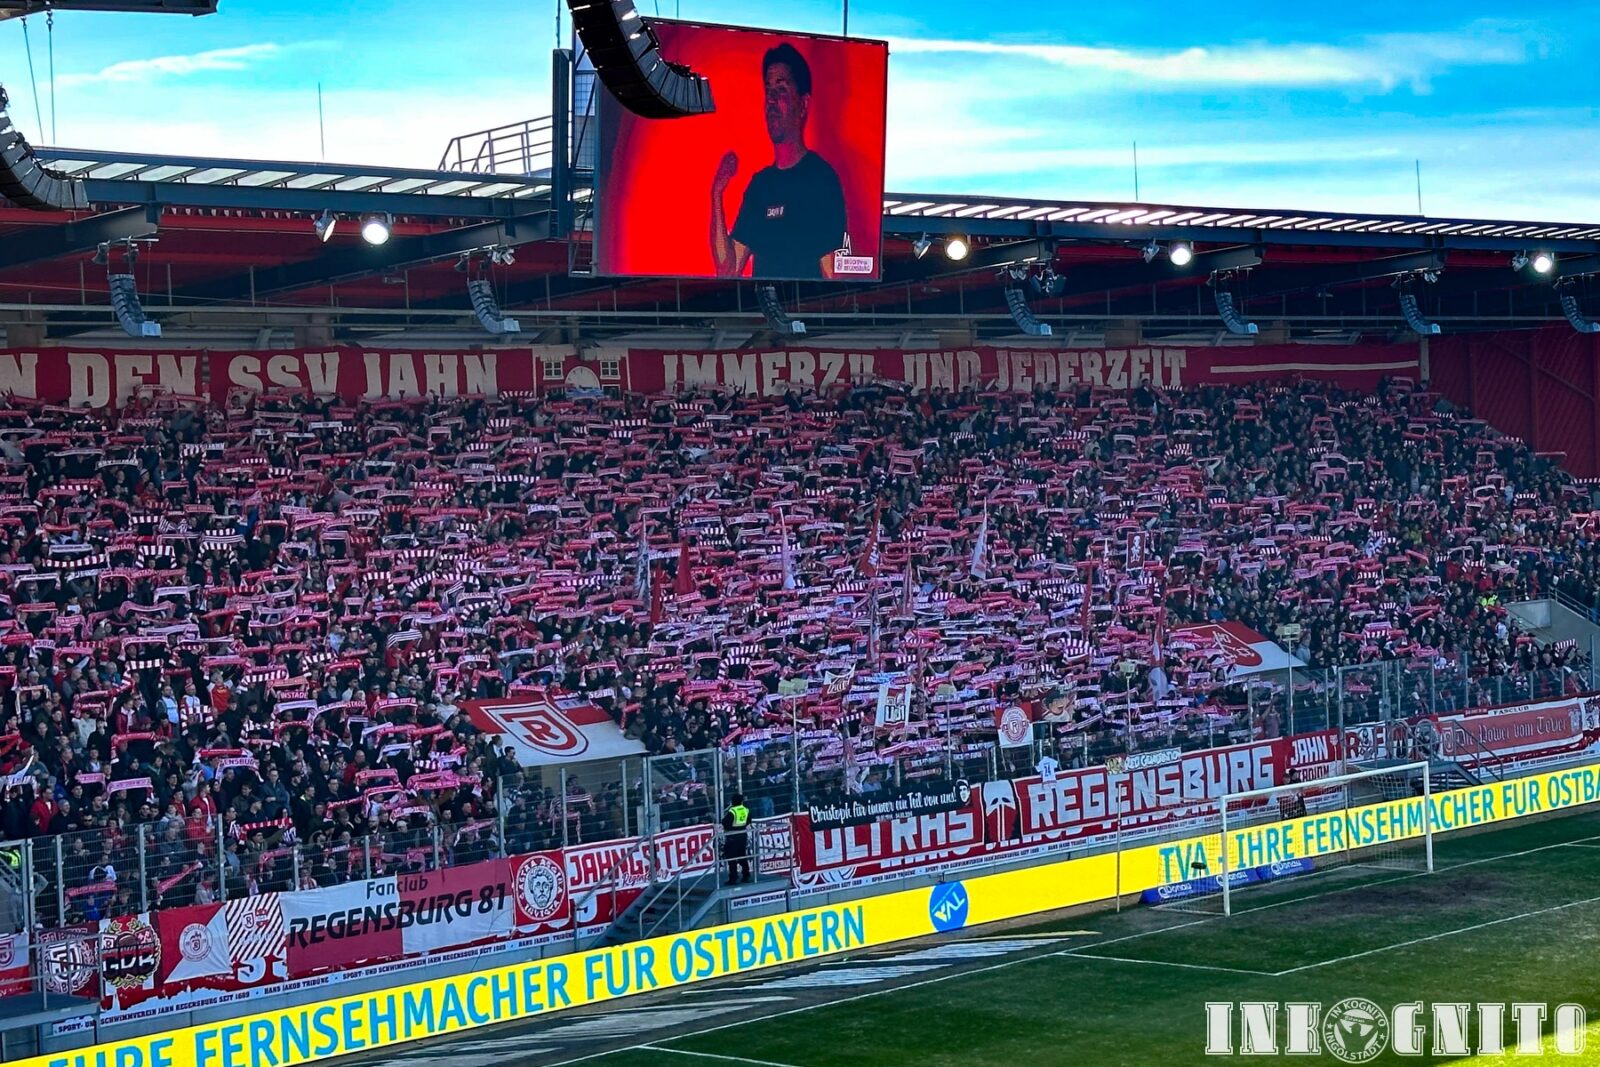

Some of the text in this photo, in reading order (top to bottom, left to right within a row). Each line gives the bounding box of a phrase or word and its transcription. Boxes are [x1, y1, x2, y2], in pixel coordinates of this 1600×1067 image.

[67, 352, 198, 409] DEN
[228, 352, 340, 402] SSV
[363, 352, 497, 400] JAHN
[663, 349, 1187, 399] IMMERZU UND JEDERZEIT
[1290, 734, 1329, 767] JAHN
[810, 804, 851, 825] Christoph
[852, 800, 866, 817] für
[867, 795, 894, 814] immer
[895, 792, 908, 809] ein
[906, 789, 923, 809] Teil
[923, 792, 939, 807] von
[940, 786, 957, 804] uns!
[1028, 745, 1275, 830] REGENSBURG
[814, 810, 974, 867] ULTRAS
[1159, 841, 1210, 884] TVA
[1236, 824, 1295, 869] IHRE
[1303, 788, 1496, 856] FERNSEHMACHER
[288, 882, 506, 950] REGENSBURG 81
[366, 876, 429, 900] Fanclub
[194, 962, 572, 1067] FERNSEHMACHER
[670, 905, 865, 983] OSTBAYERN
